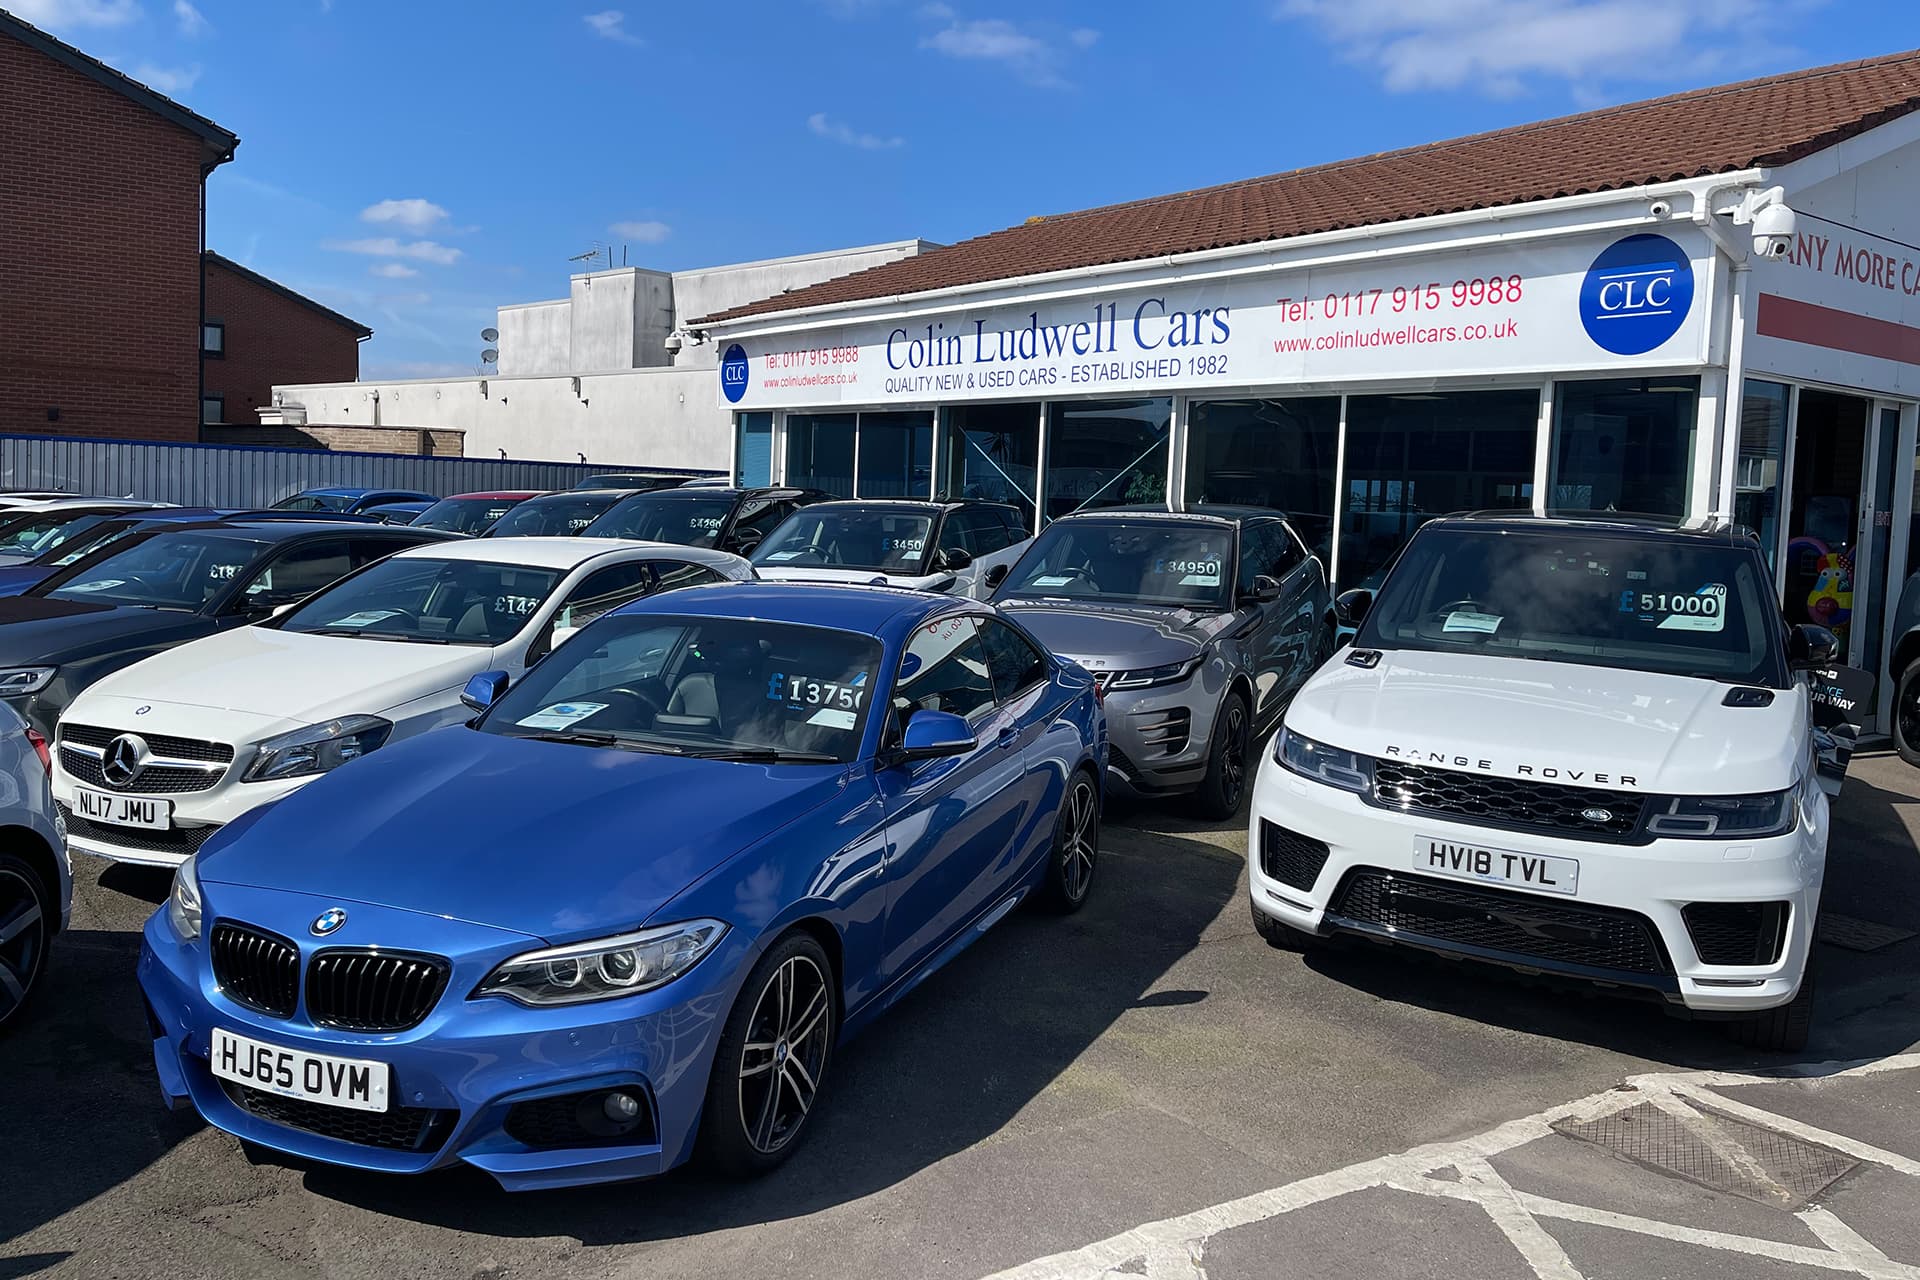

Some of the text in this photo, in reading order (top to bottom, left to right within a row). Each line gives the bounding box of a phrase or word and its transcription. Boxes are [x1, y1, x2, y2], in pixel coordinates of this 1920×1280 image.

[1834, 241, 1896, 290] MORE
[1277, 274, 1523, 323] Tel: 0117 915 9988
[1599, 277, 1672, 311] CLC
[886, 297, 1231, 370] Colin Ludwell Cars
[1273, 318, 1518, 353] www.colinludwellcars.co.uk
[726, 365, 745, 381] CLC
[764, 345, 859, 369] Tel: 0117 915 9988
[885, 375, 932, 394] QUALITY
[935, 373, 963, 391] NEW
[967, 373, 975, 389] &
[978, 370, 1014, 388] USED
[1018, 366, 1057, 386] CARS
[1071, 358, 1181, 383] ESTABLISHED
[1188, 354, 1228, 376] 1982
[763, 373, 858, 389] www.colinludwellcars.co.uk
[209, 564, 243, 579] £18
[1619, 590, 1717, 614] £51000
[1711, 585, 1725, 595] 70
[1828, 696, 1856, 710] WAY
[1385, 745, 1638, 786] RANGE ROVER
[80, 792, 155, 823] NL17 JMU
[1429, 842, 1556, 885] HV18 TVL
[222, 1036, 370, 1102] HJ65 OVM
